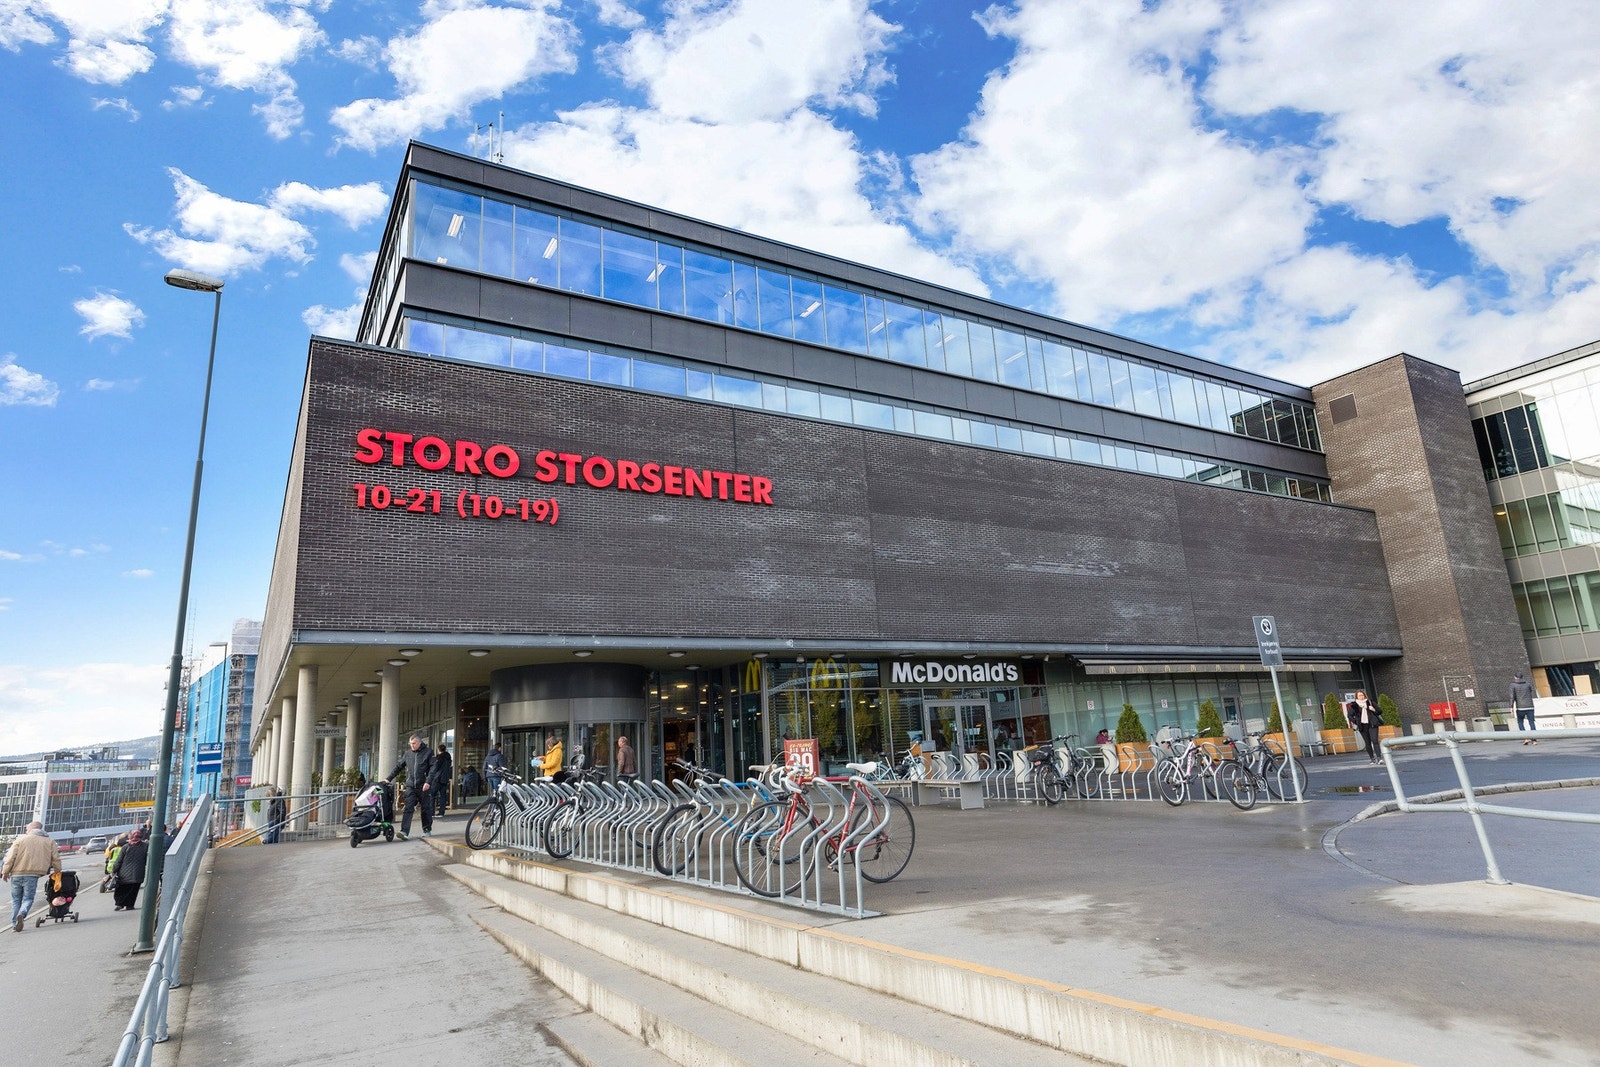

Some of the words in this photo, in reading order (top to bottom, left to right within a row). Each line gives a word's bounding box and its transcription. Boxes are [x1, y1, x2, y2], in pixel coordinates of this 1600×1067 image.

[354, 428, 520, 478] STORO
[535, 450, 774, 506] STORSENTER
[353, 483, 441, 514] 10-21
[457, 489, 559, 526] (10-19)
[891, 661, 1019, 684] McDonald's
